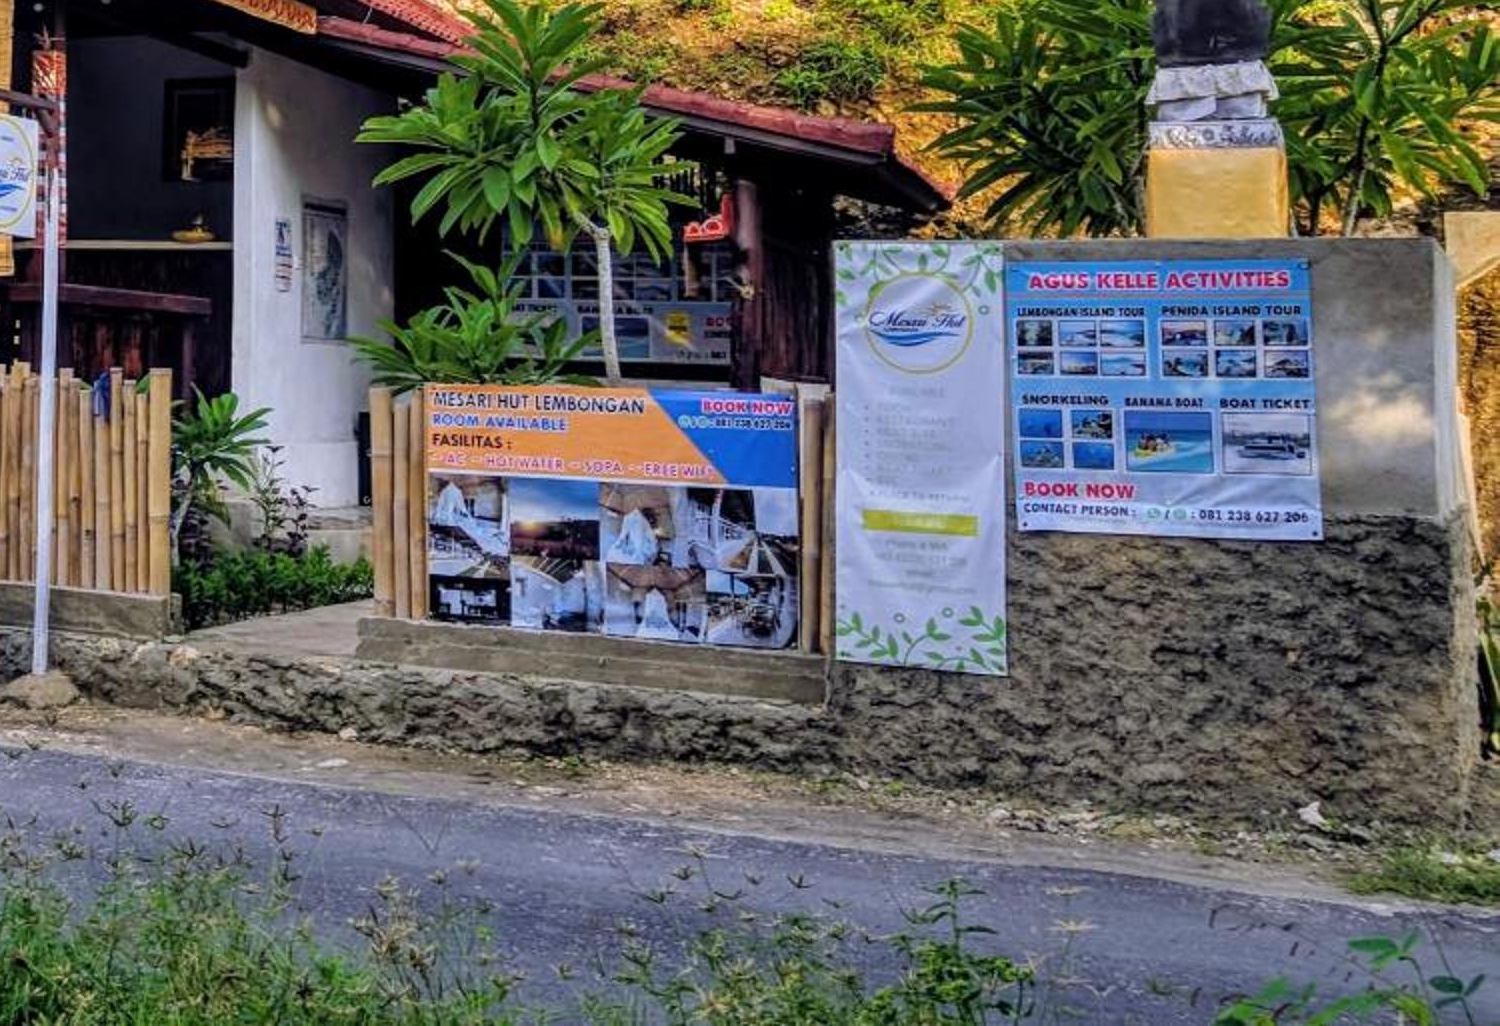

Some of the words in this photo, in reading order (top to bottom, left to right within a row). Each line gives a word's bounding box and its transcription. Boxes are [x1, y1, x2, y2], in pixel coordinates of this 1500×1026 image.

[1028, 272, 1089, 289] AGUS
[1097, 272, 1157, 289] KELLE
[1166, 271, 1289, 288] ACTIVITIES
[1016, 307, 1077, 317] LEMBONGAN
[1080, 307, 1115, 317] ISLAND
[1118, 307, 1145, 317] TOUR
[1161, 305, 1208, 316] PENIDA
[1213, 305, 1261, 316] ISLAND
[1265, 305, 1301, 316] TOUR
[433, 392, 491, 409] MESARI
[497, 393, 529, 410] HUT
[535, 395, 645, 414] LEMBONGAN
[704, 400, 747, 414] BOOK
[752, 401, 792, 415] NOW
[1021, 394, 1109, 406] SNORKELING
[1124, 397, 1173, 408] BANANA
[1175, 397, 1204, 408] BOAT
[1219, 398, 1257, 409] BOAT
[1262, 398, 1311, 410] TICKET
[433, 413, 479, 427] ROOM
[485, 416, 567, 431] AVAILABLE
[432, 433, 503, 449] FASILITAS
[486, 454, 514, 468] HOT
[518, 455, 563, 470] WATER
[645, 463, 677, 477] FREE
[1024, 481, 1078, 497] BOOK
[1085, 482, 1135, 499] NOW
[1023, 503, 1078, 515] CONTACT
[1081, 505, 1129, 517] PERSON
[1199, 509, 1222, 520] 081
[1227, 510, 1251, 522] 238
[1255, 512, 1279, 523] 627
[1283, 512, 1309, 523] 206
